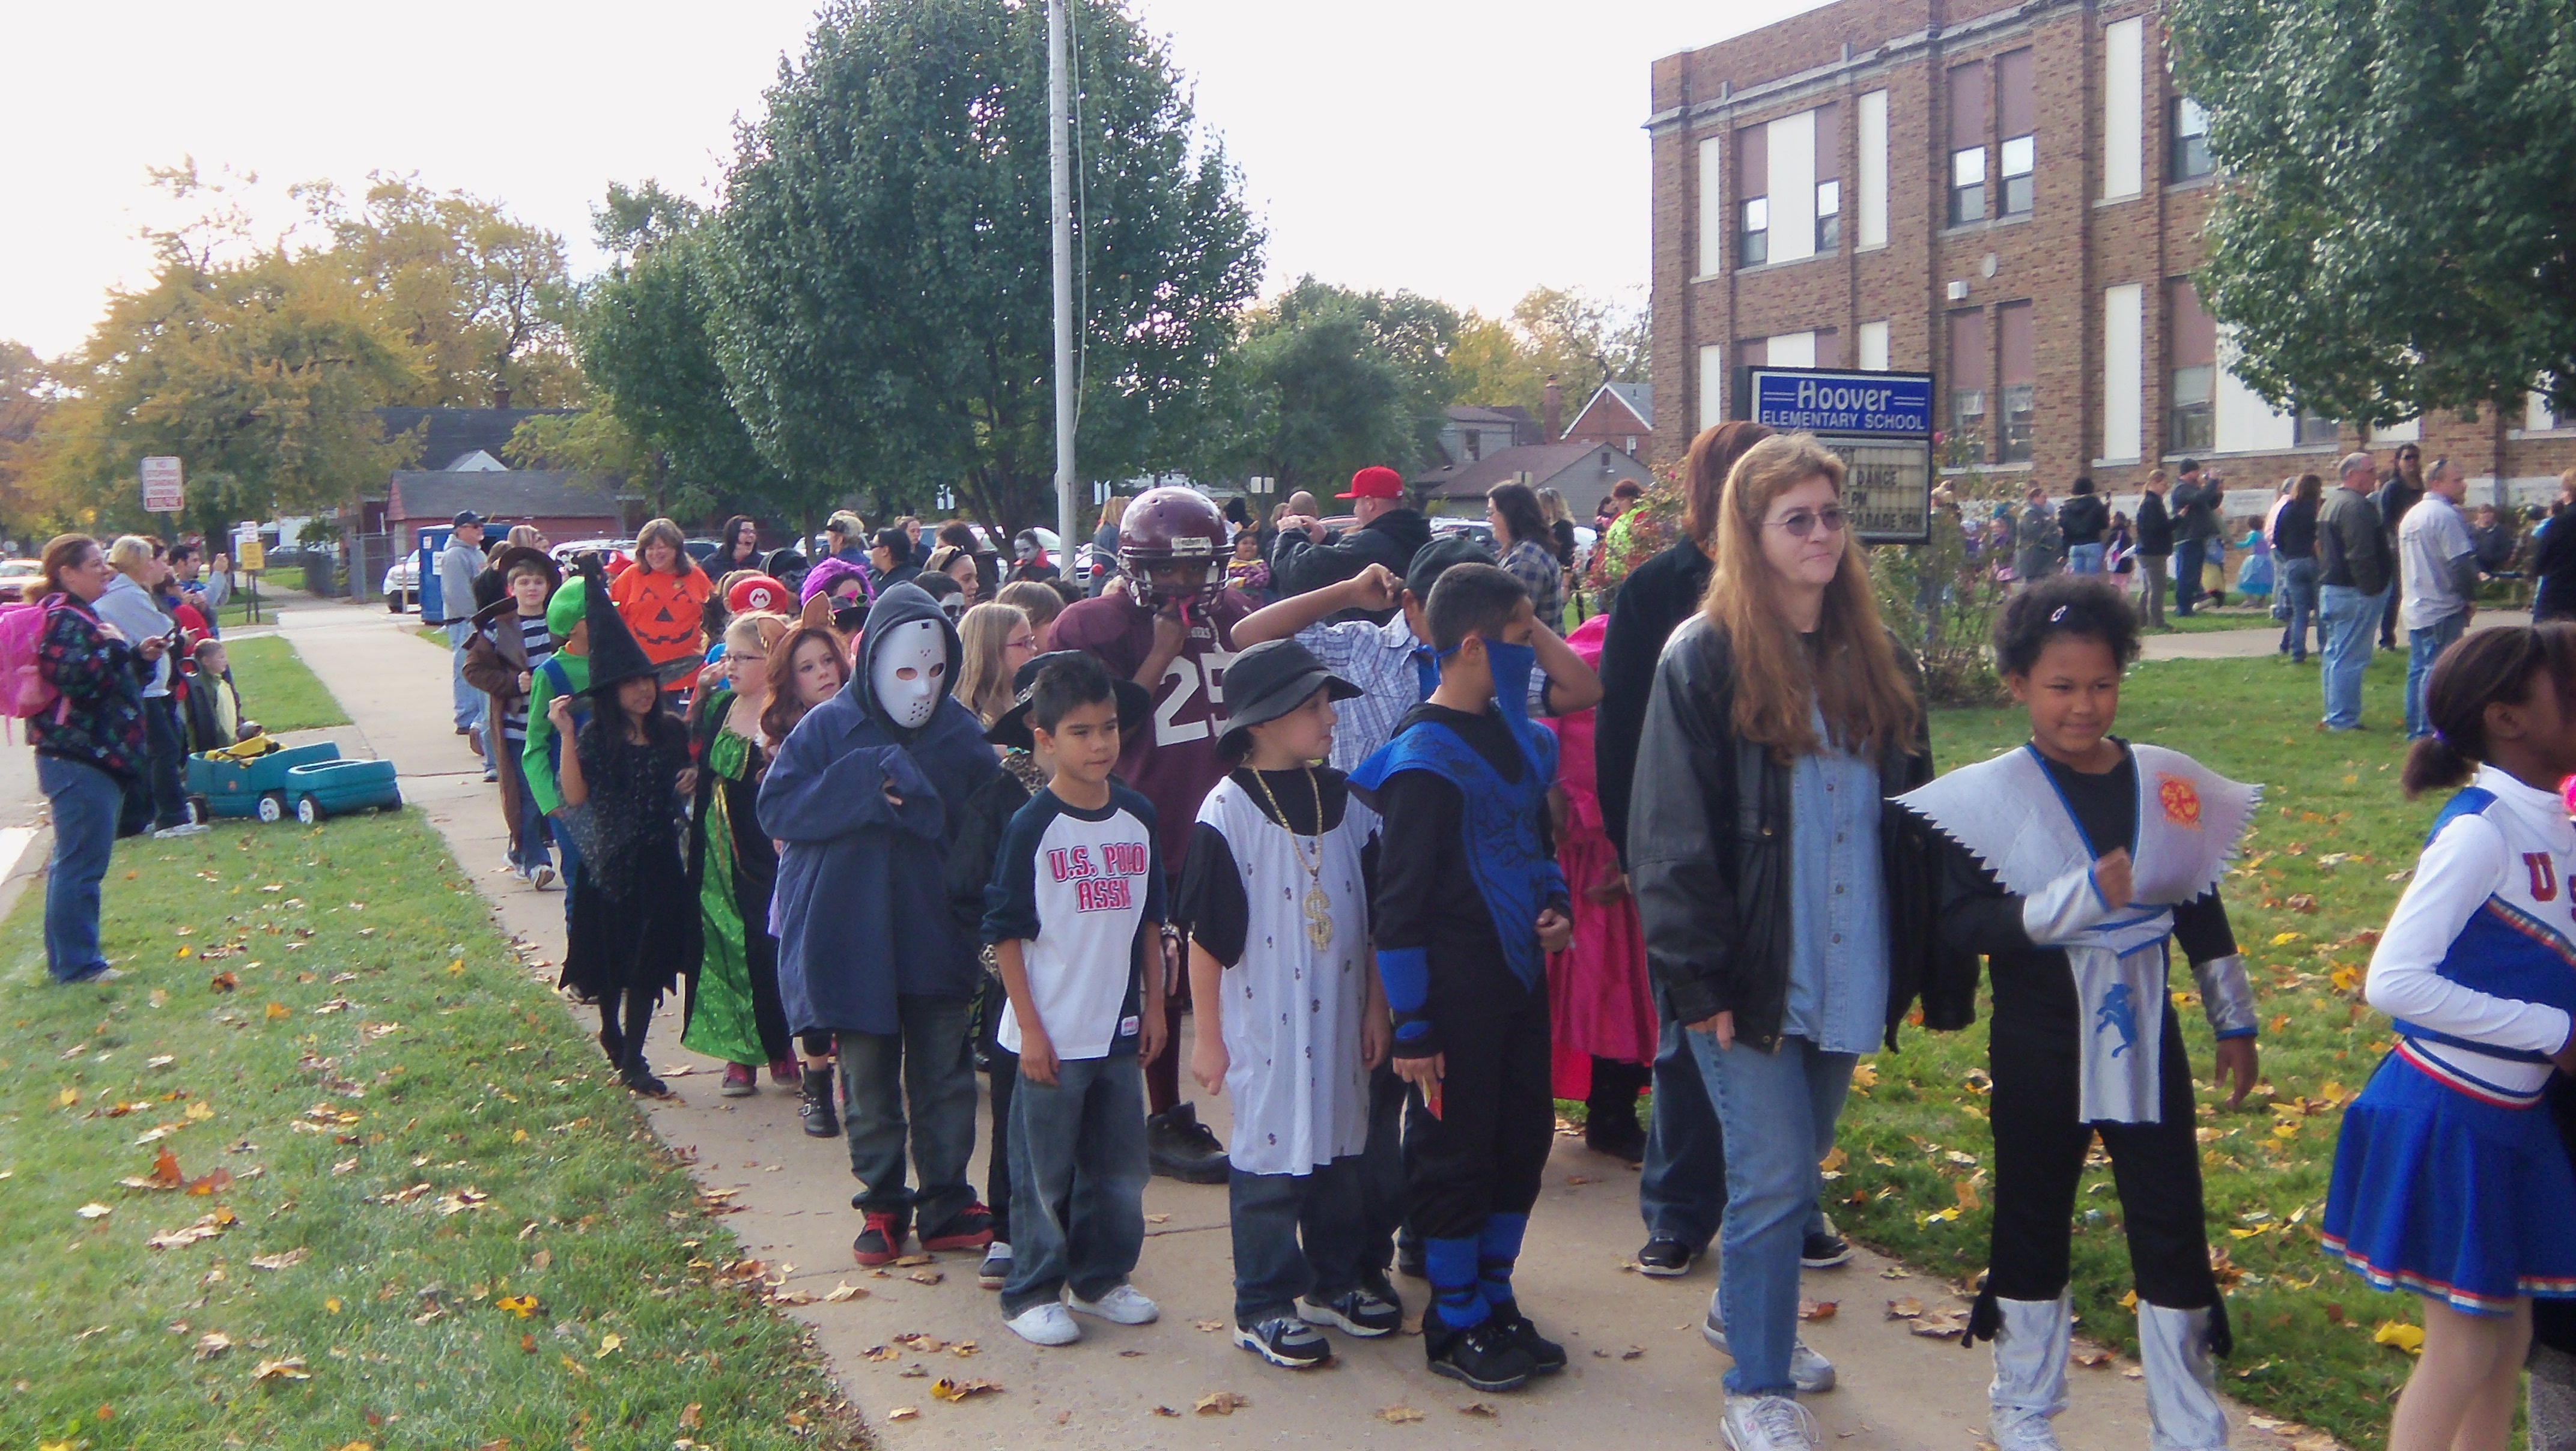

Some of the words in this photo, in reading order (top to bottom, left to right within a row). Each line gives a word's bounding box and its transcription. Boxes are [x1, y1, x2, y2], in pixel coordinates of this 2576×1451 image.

[1797, 380, 1892, 411] Hoover
[1762, 410, 1859, 428] ELEMENTARY
[1865, 413, 1925, 430] SCHOOL
[753, 593, 768, 602] M
[1153, 652, 1238, 747] 25
[1047, 846, 1098, 883] U.S.
